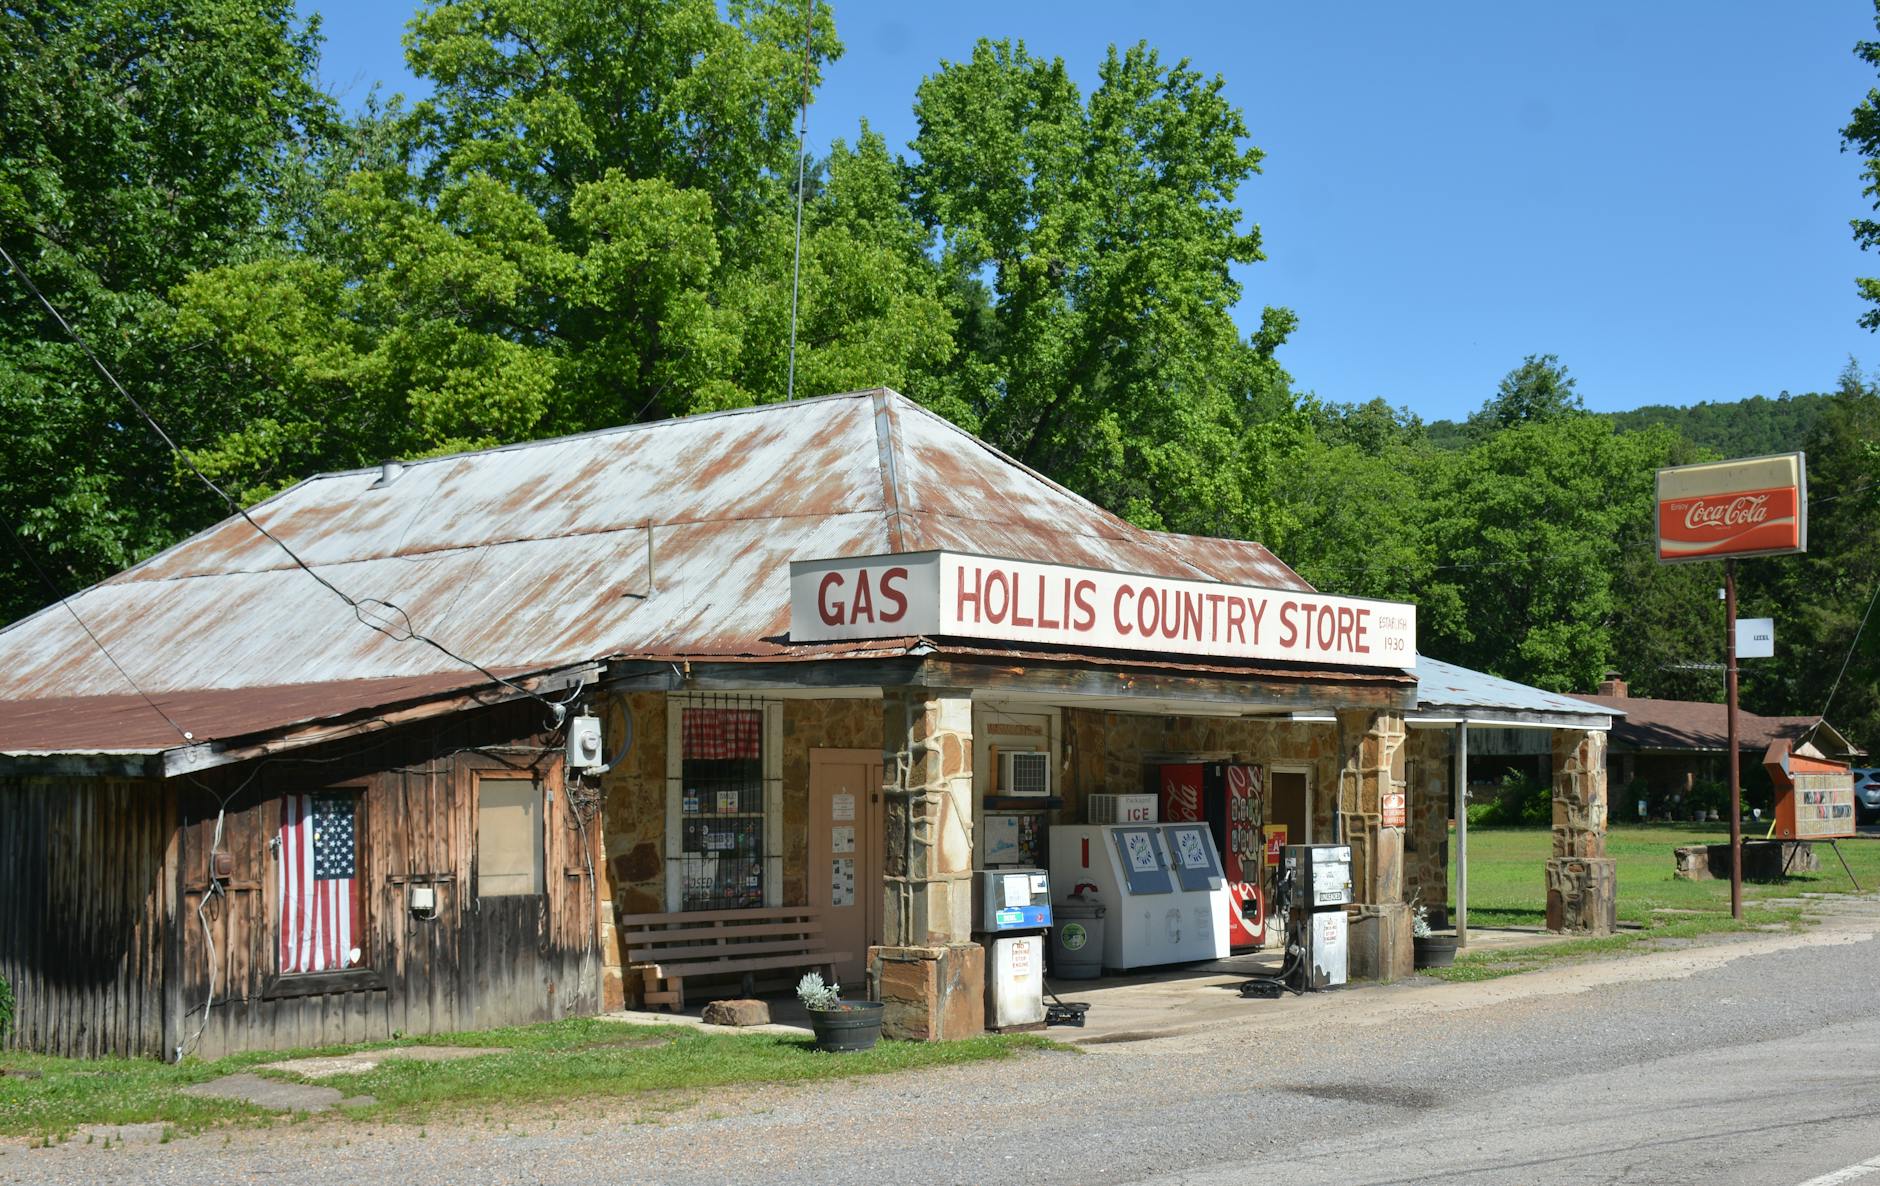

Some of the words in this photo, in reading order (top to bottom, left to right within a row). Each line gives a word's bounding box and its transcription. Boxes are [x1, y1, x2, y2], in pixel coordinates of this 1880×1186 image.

[1685, 494, 1770, 529] Coca-Cola
[818, 567, 908, 626] GAS
[957, 566, 1096, 632] HOLLIS
[1113, 584, 1268, 645] COUNTRY
[1279, 600, 1371, 653] STORE
[1384, 637, 1405, 651] 1930
[1128, 807, 1149, 821] ICE
